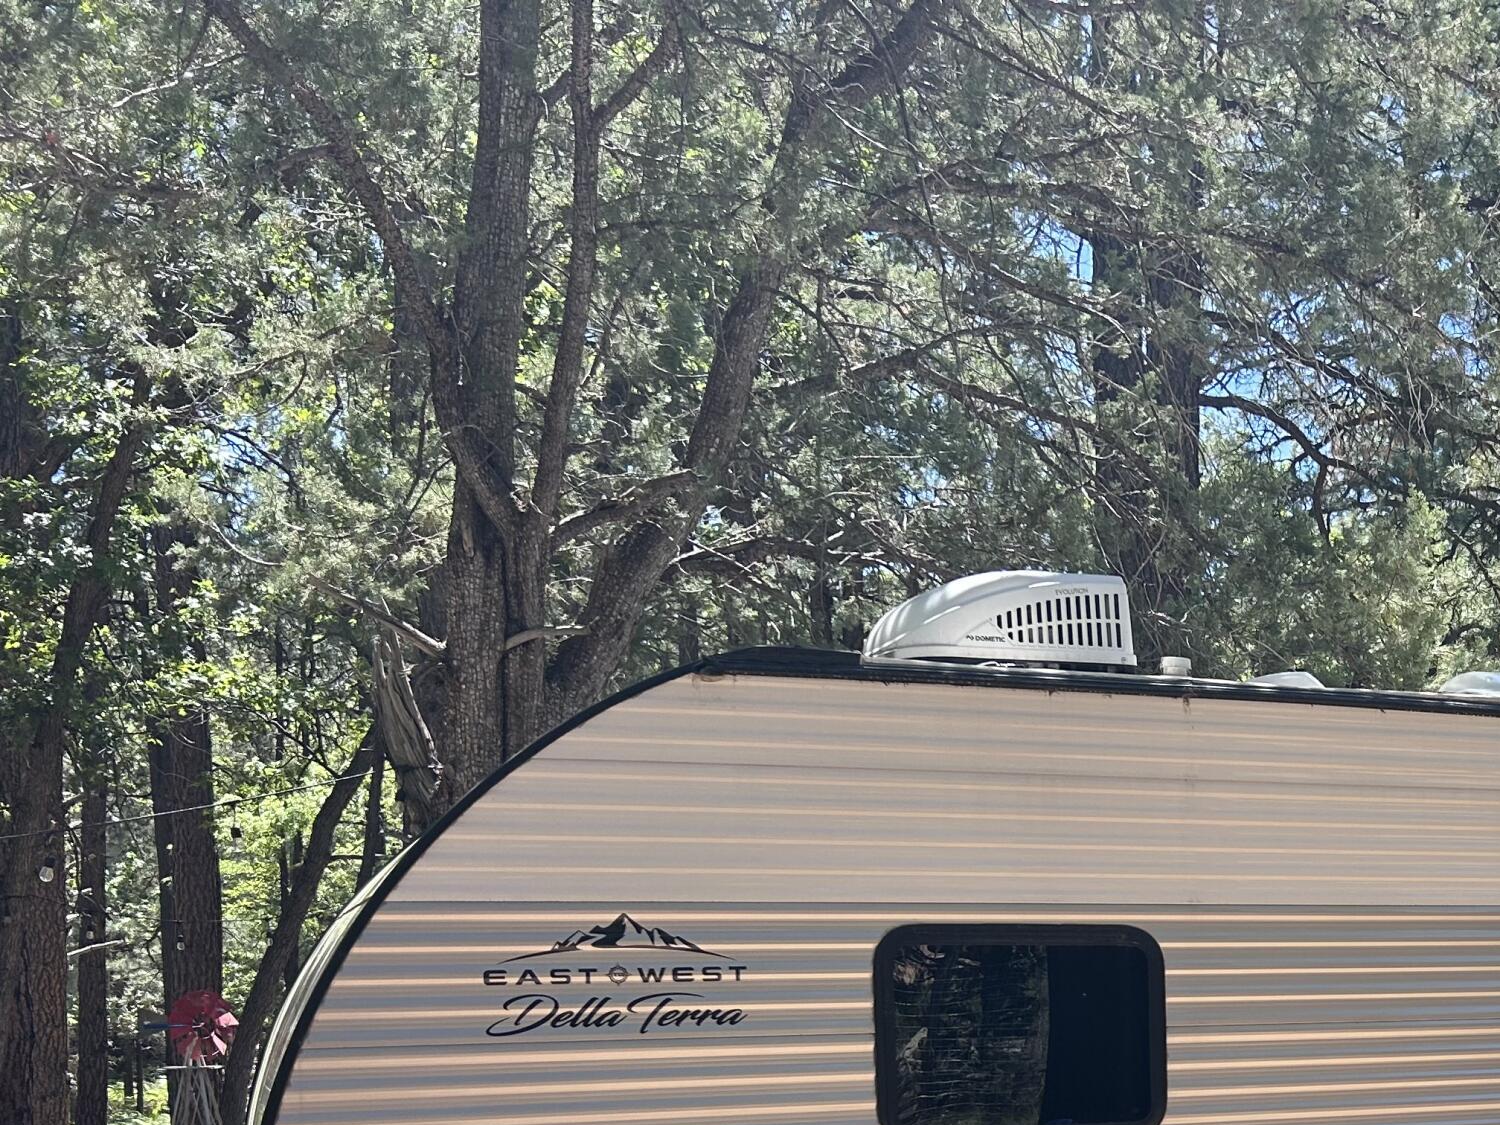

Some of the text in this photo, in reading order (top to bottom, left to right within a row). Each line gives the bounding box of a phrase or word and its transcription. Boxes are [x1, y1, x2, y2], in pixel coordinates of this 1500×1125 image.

[975, 635, 1006, 643] DOMETIC
[483, 965, 748, 986] EAST WEST
[485, 992, 749, 1037] Della Terra
